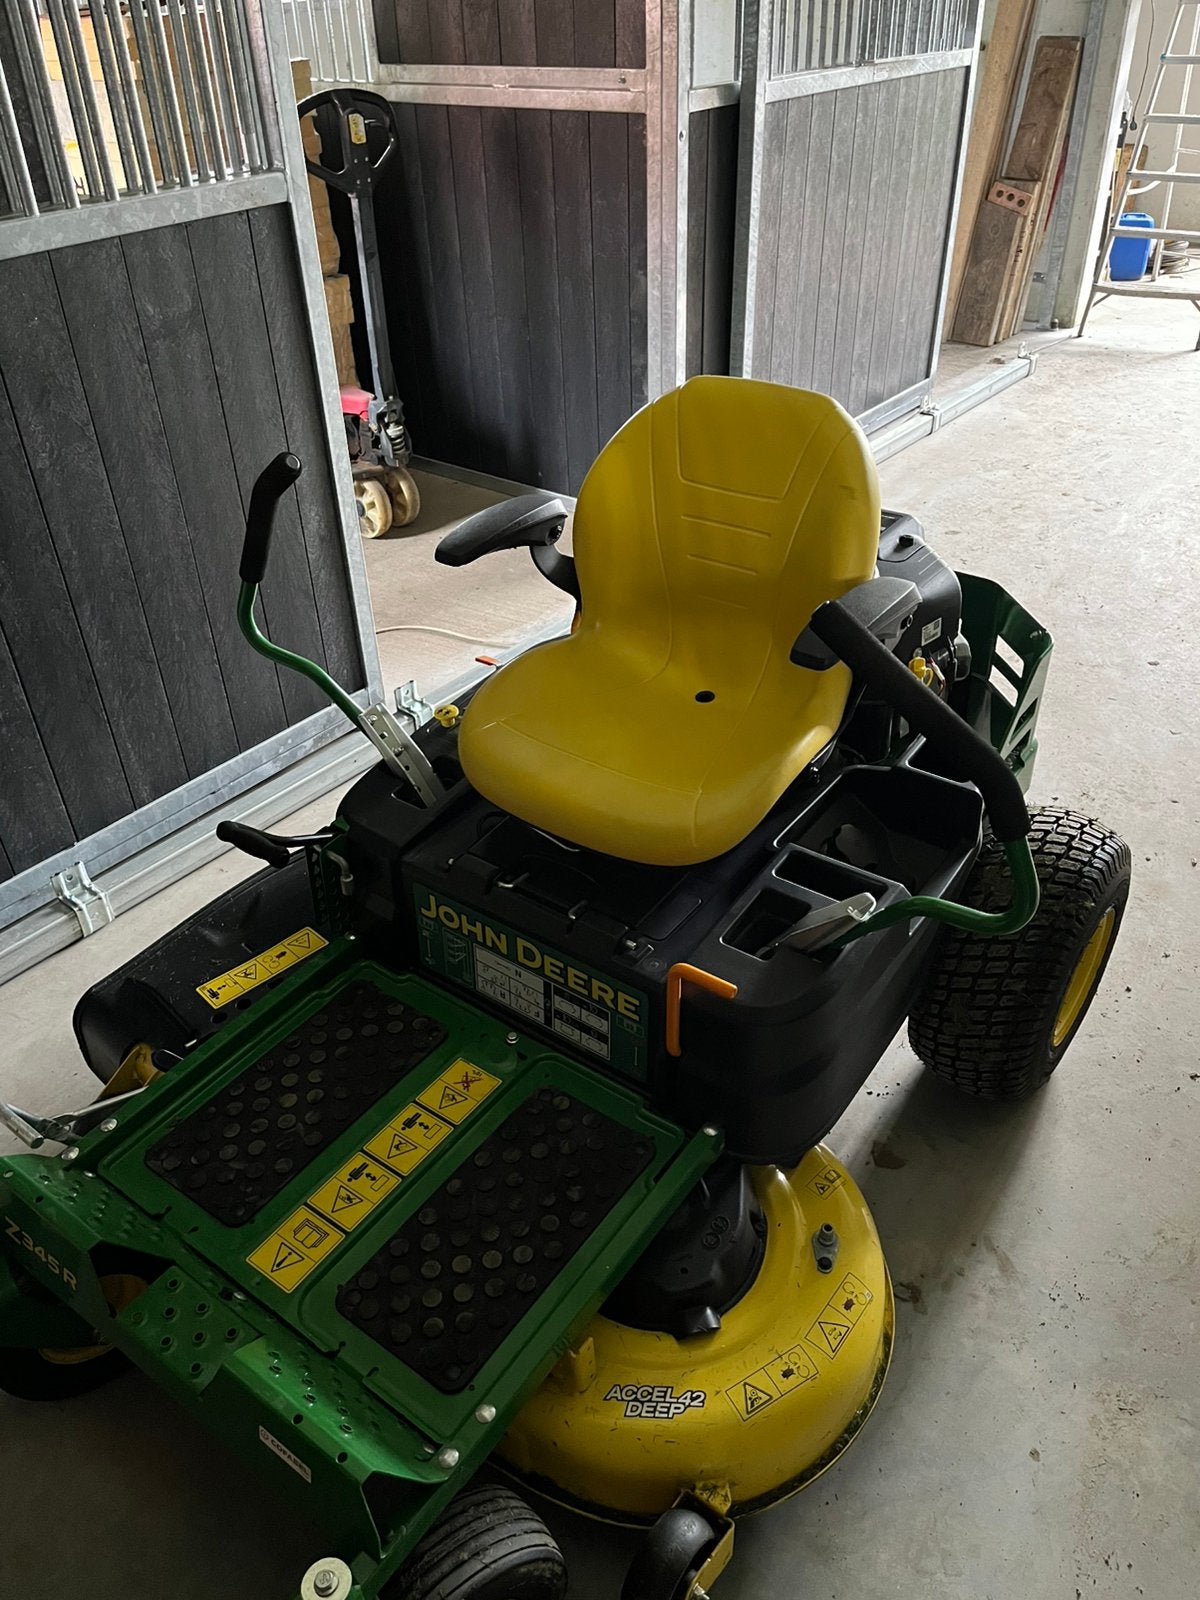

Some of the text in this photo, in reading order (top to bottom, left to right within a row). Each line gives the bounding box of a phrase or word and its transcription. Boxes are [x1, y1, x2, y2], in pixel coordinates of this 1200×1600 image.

[421, 895, 640, 1021] JOHN DEERE
[5, 1216, 77, 1290] Z345R
[604, 1384, 706, 1407] ACCEL 42
[624, 1401, 686, 1419] DEEP
